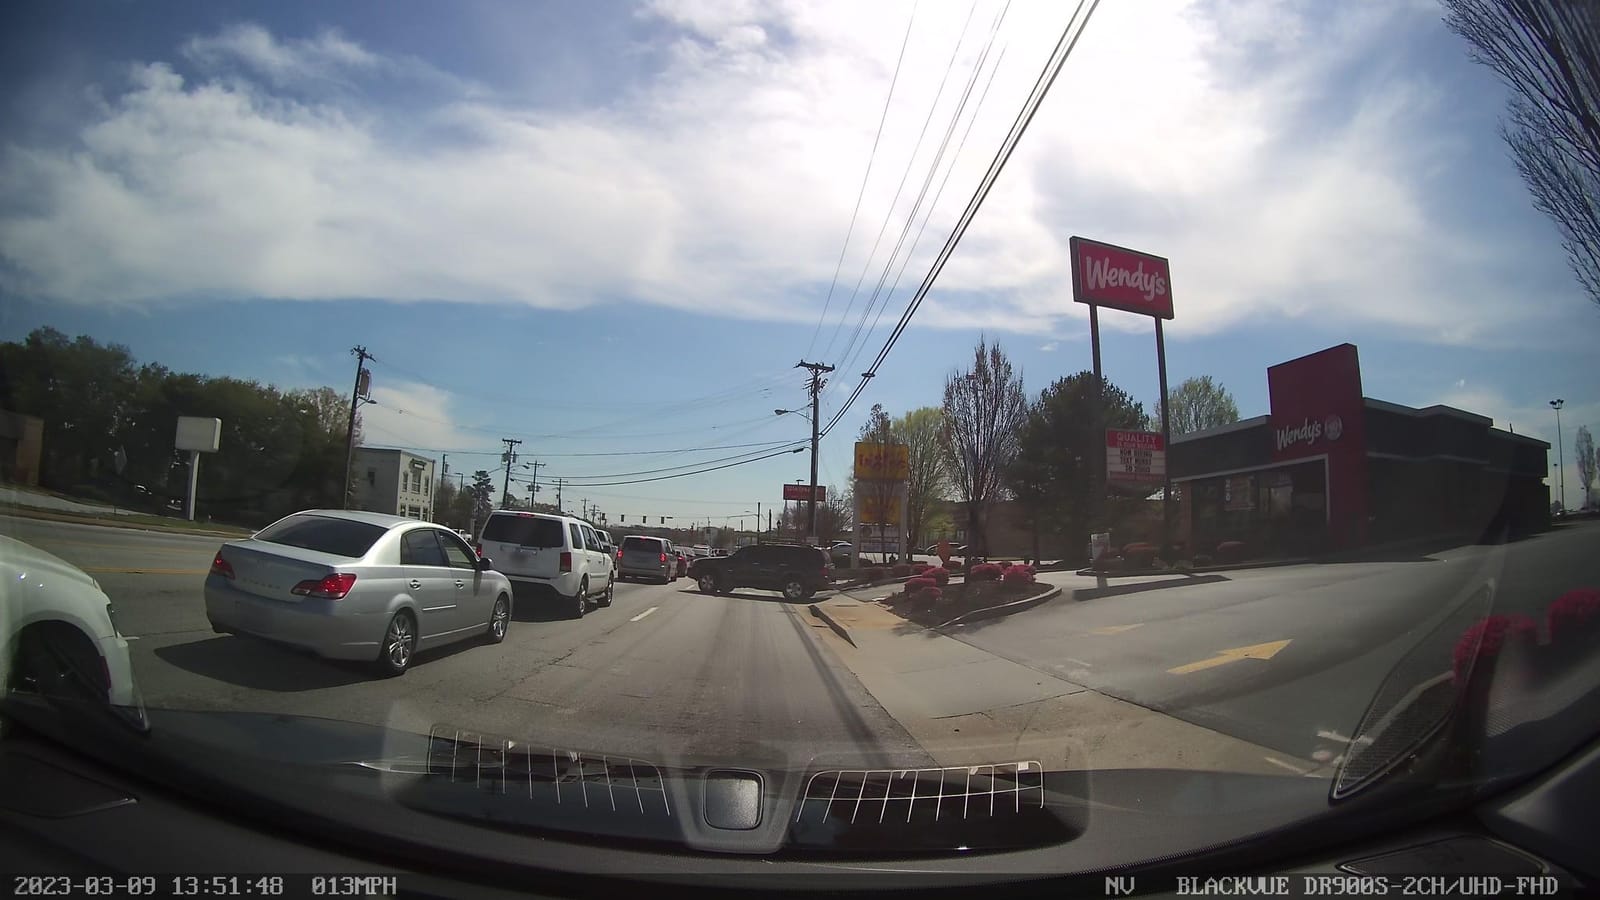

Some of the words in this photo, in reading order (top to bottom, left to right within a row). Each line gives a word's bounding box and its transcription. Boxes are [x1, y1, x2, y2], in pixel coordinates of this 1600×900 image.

[1085, 256, 1166, 301] Wendy's
[1116, 433, 1157, 443] QUALITY
[1276, 418, 1321, 451] Wendy's
